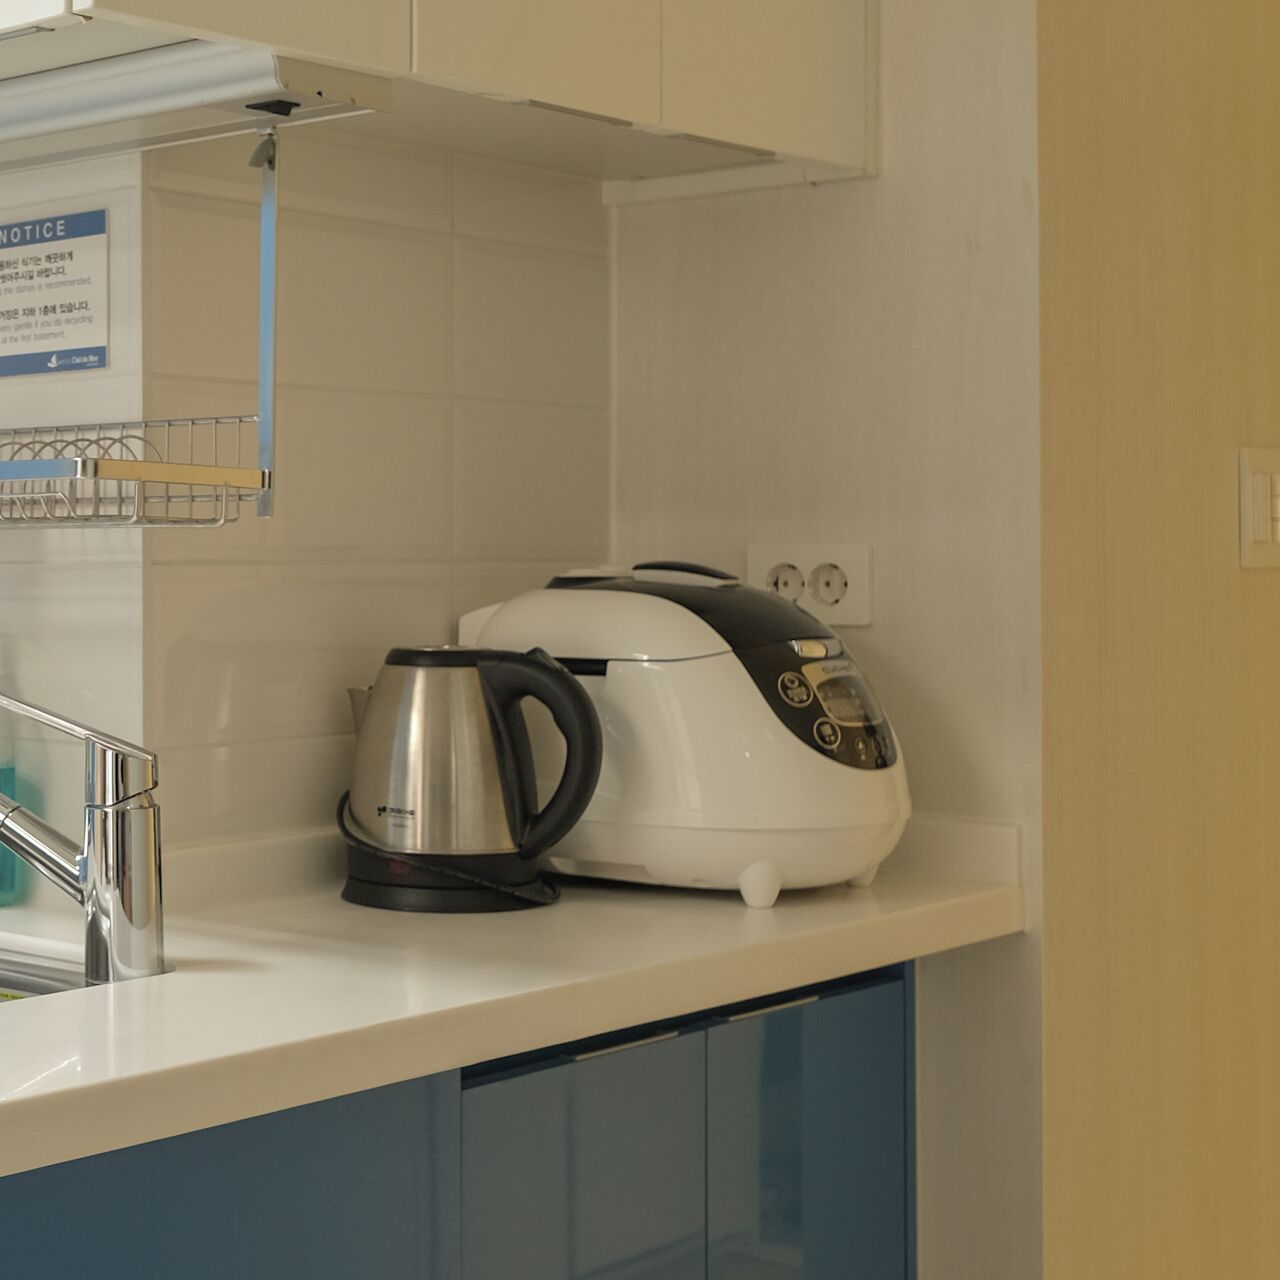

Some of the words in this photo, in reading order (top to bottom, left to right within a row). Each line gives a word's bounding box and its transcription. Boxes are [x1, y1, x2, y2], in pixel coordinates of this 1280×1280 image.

[22, 256, 42, 266] 식기는
[45, 251, 73, 264] 깨끗하게
[0, 270, 34, 284] 씻어주시길
[39, 304, 57, 316] 1층에
